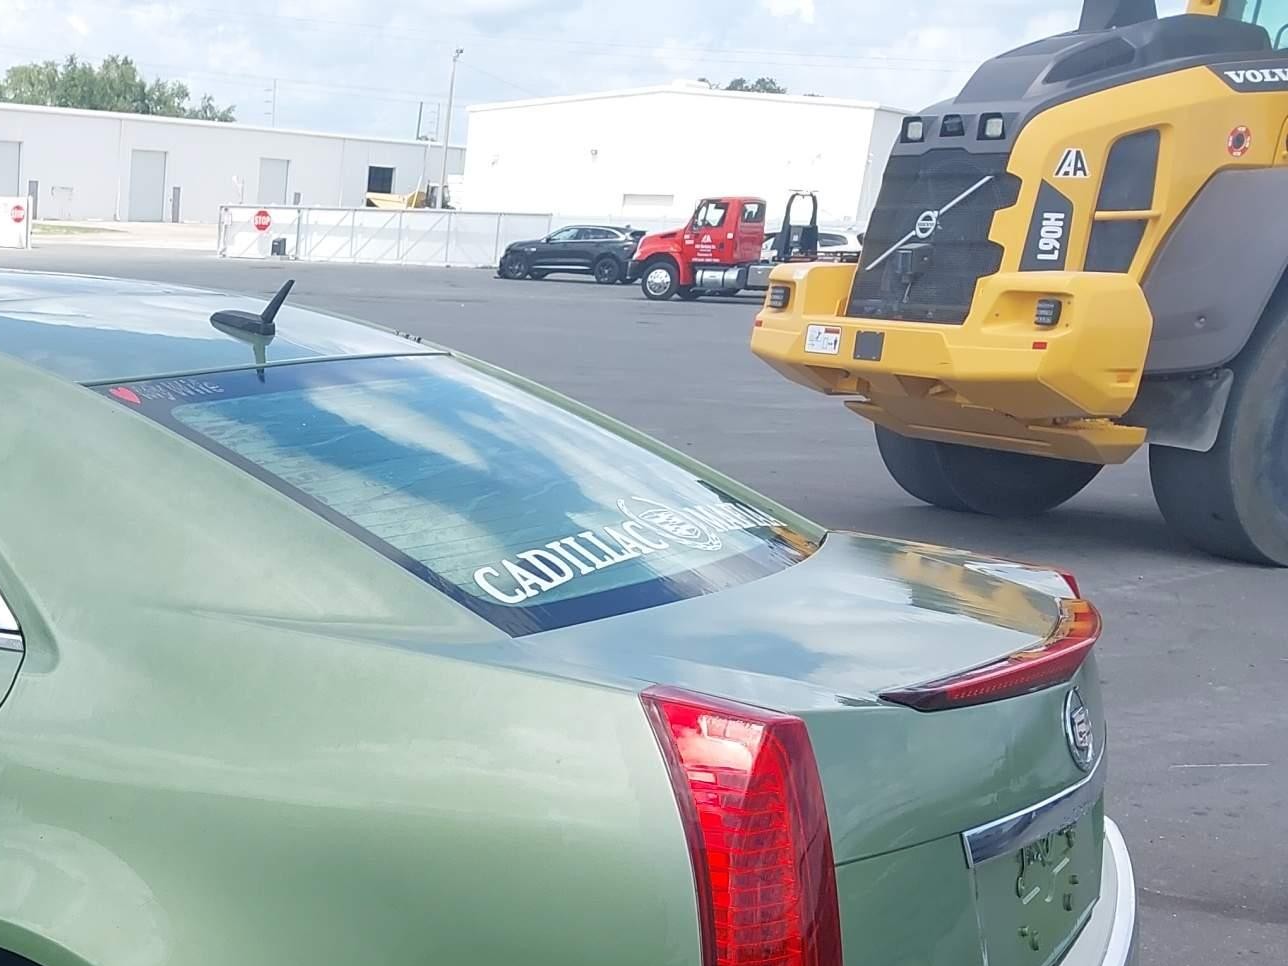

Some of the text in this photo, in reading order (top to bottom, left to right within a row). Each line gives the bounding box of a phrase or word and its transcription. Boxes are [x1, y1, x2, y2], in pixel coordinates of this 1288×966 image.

[254, 215, 270, 226] STOP
[1037, 212, 1065, 260] L90H
[473, 520, 669, 604] CADILLAC
